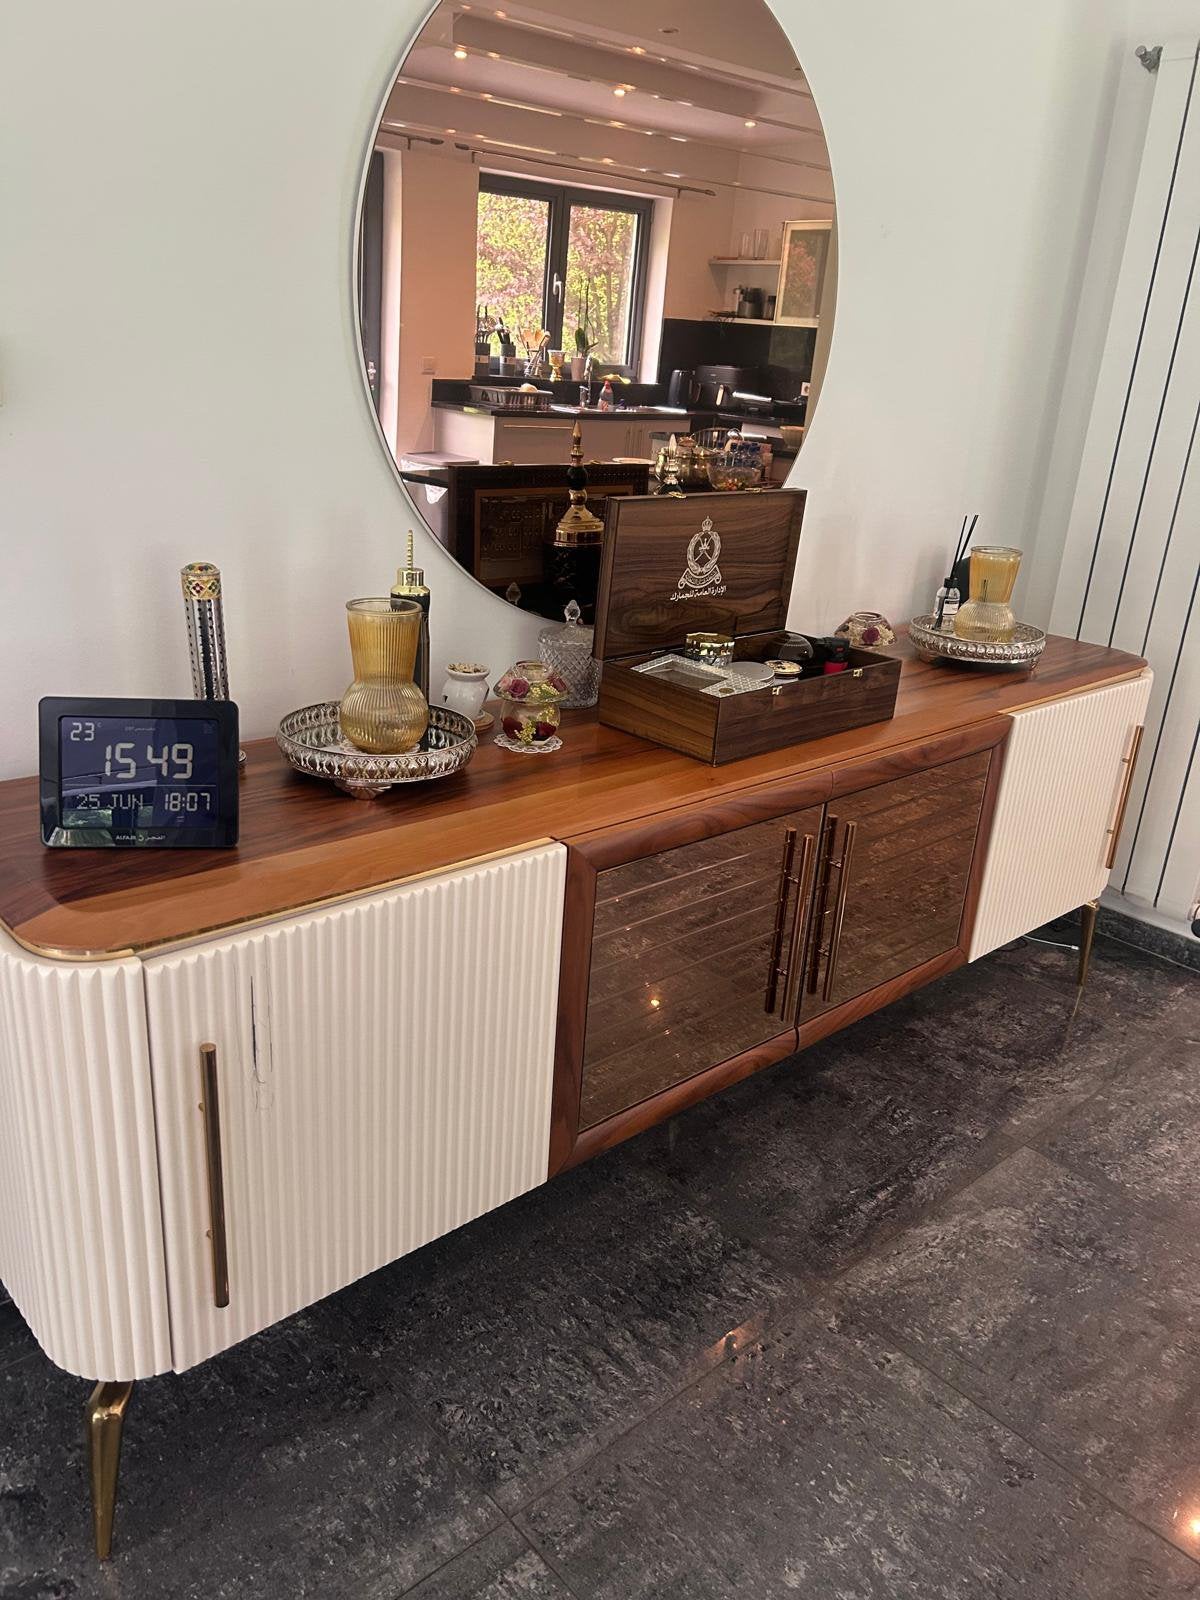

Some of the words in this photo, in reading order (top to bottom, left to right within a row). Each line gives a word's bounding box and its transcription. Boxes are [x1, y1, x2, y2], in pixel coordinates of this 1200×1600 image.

[670, 590, 694, 602] للجمارك
[694, 588, 711, 597] العامة
[711, 585, 726, 596] الإدارة
[70, 722, 95, 742] 23
[76, 793, 101, 810] 25
[106, 793, 144, 810] JUN
[164, 792, 211, 811] 18:07
